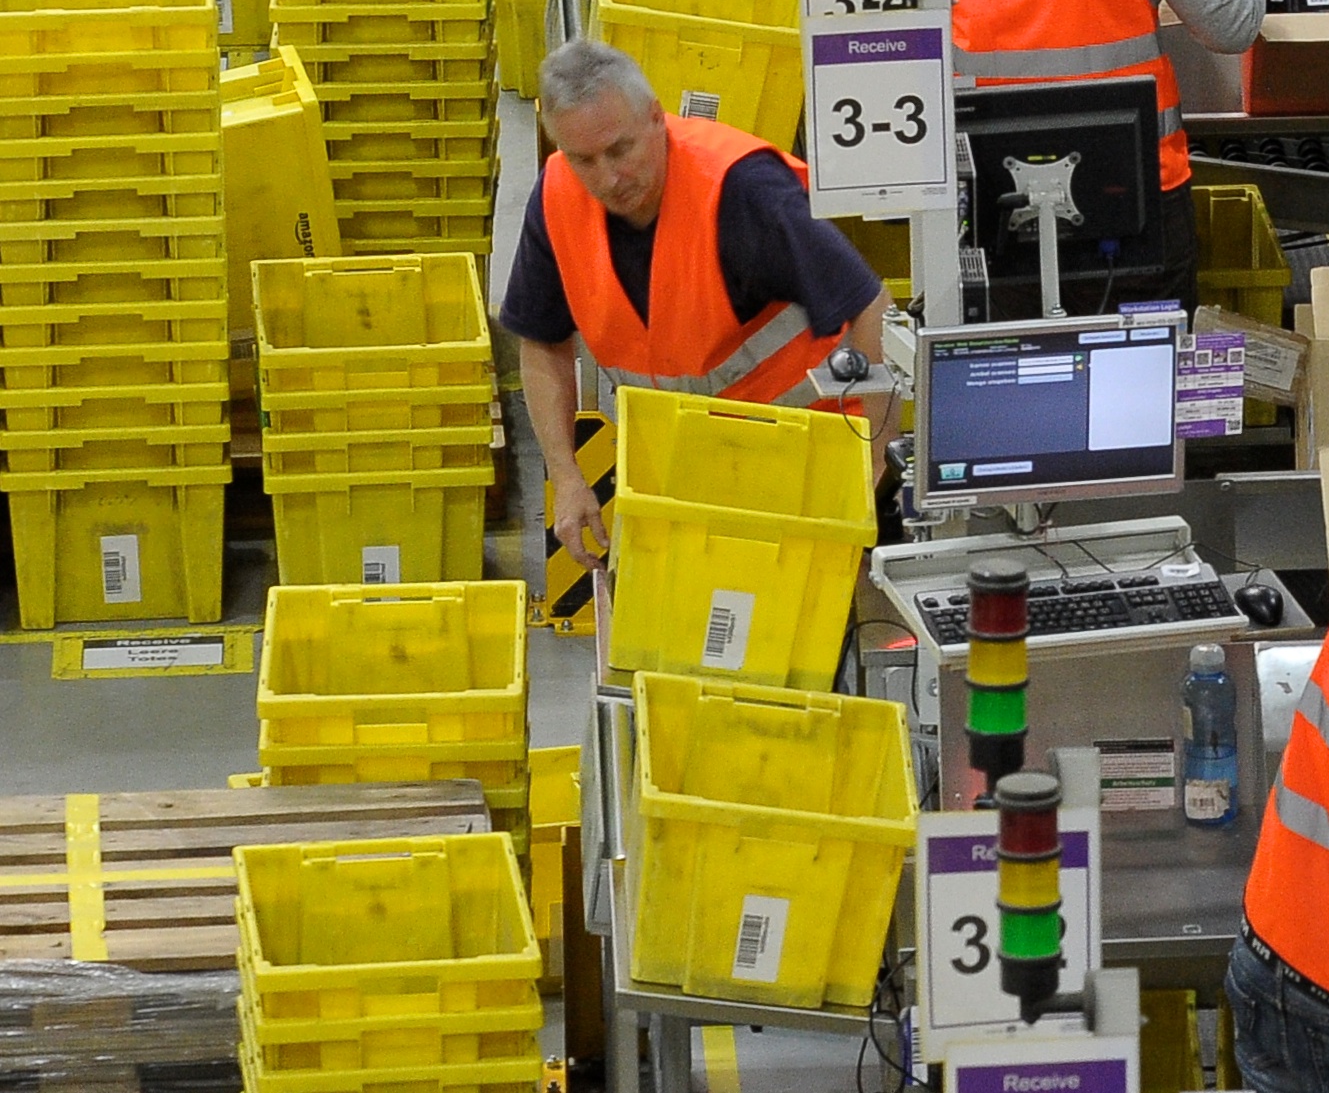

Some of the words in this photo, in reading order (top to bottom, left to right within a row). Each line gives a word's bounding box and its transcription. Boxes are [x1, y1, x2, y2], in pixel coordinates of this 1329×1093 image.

[848, 39, 907, 54] Receive
[832, 95, 927, 147] 3-3
[116, 638, 191, 647] Receive
[1002, 1074, 1080, 1092] Receive
